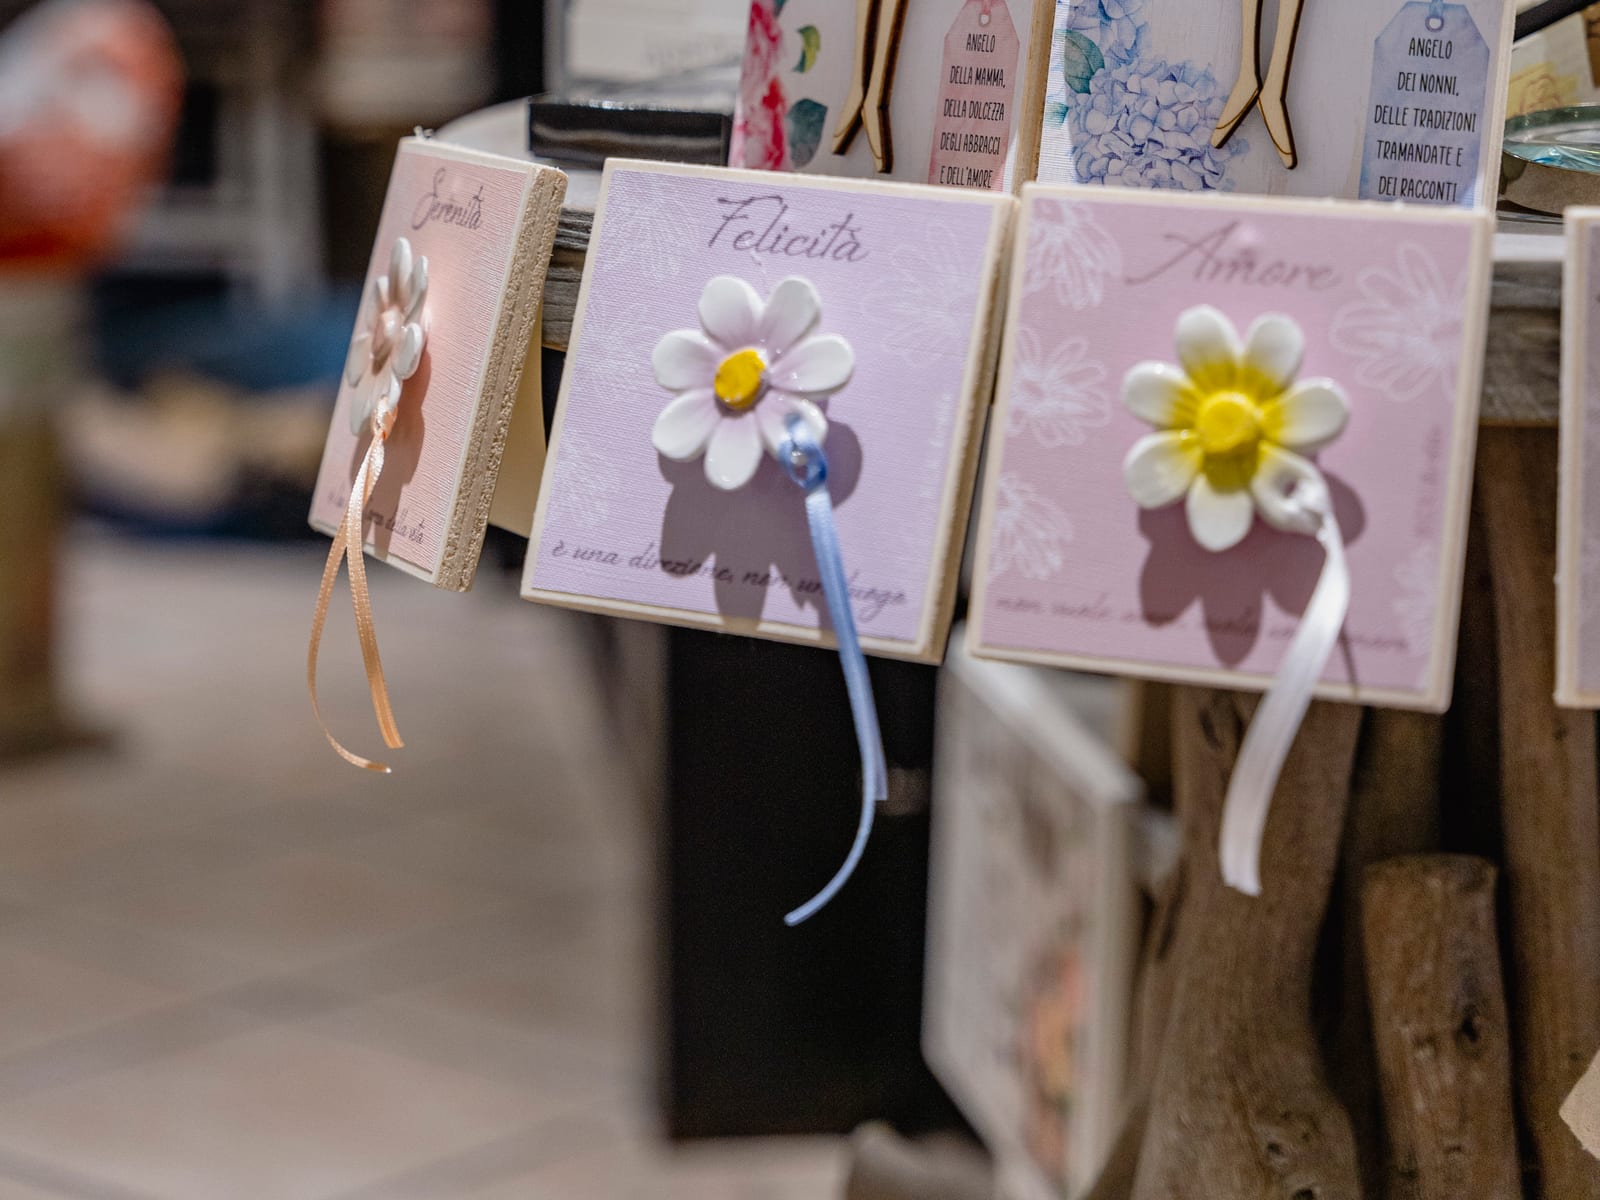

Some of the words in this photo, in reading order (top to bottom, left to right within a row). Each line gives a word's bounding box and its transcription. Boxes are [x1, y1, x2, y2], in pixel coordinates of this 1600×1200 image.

[966, 33, 996, 53] ANGELO
[1408, 37, 1453, 59] ANGELO
[949, 65, 973, 85] DELLA
[1397, 71, 1416, 92] DEI
[943, 98, 967, 118] DELLA
[968, 100, 1005, 121] DOLCEZZA
[1374, 104, 1408, 126] DELLE
[1413, 107, 1477, 133] TRADIZIONI
[940, 132, 962, 152] DEGLI
[963, 133, 1001, 155] ABBRACCI
[1376, 139, 1454, 166] TRAMANDATE
[1456, 147, 1465, 167] E
[940, 165, 946, 184] E
[946, 166, 993, 189] DELL'AMORE
[1378, 175, 1398, 196] DEI
[1400, 177, 1458, 202] RACCONTI
[708, 195, 870, 263] Felicità
[1124, 219, 1343, 290] Amore
[571, 548, 620, 566] una
